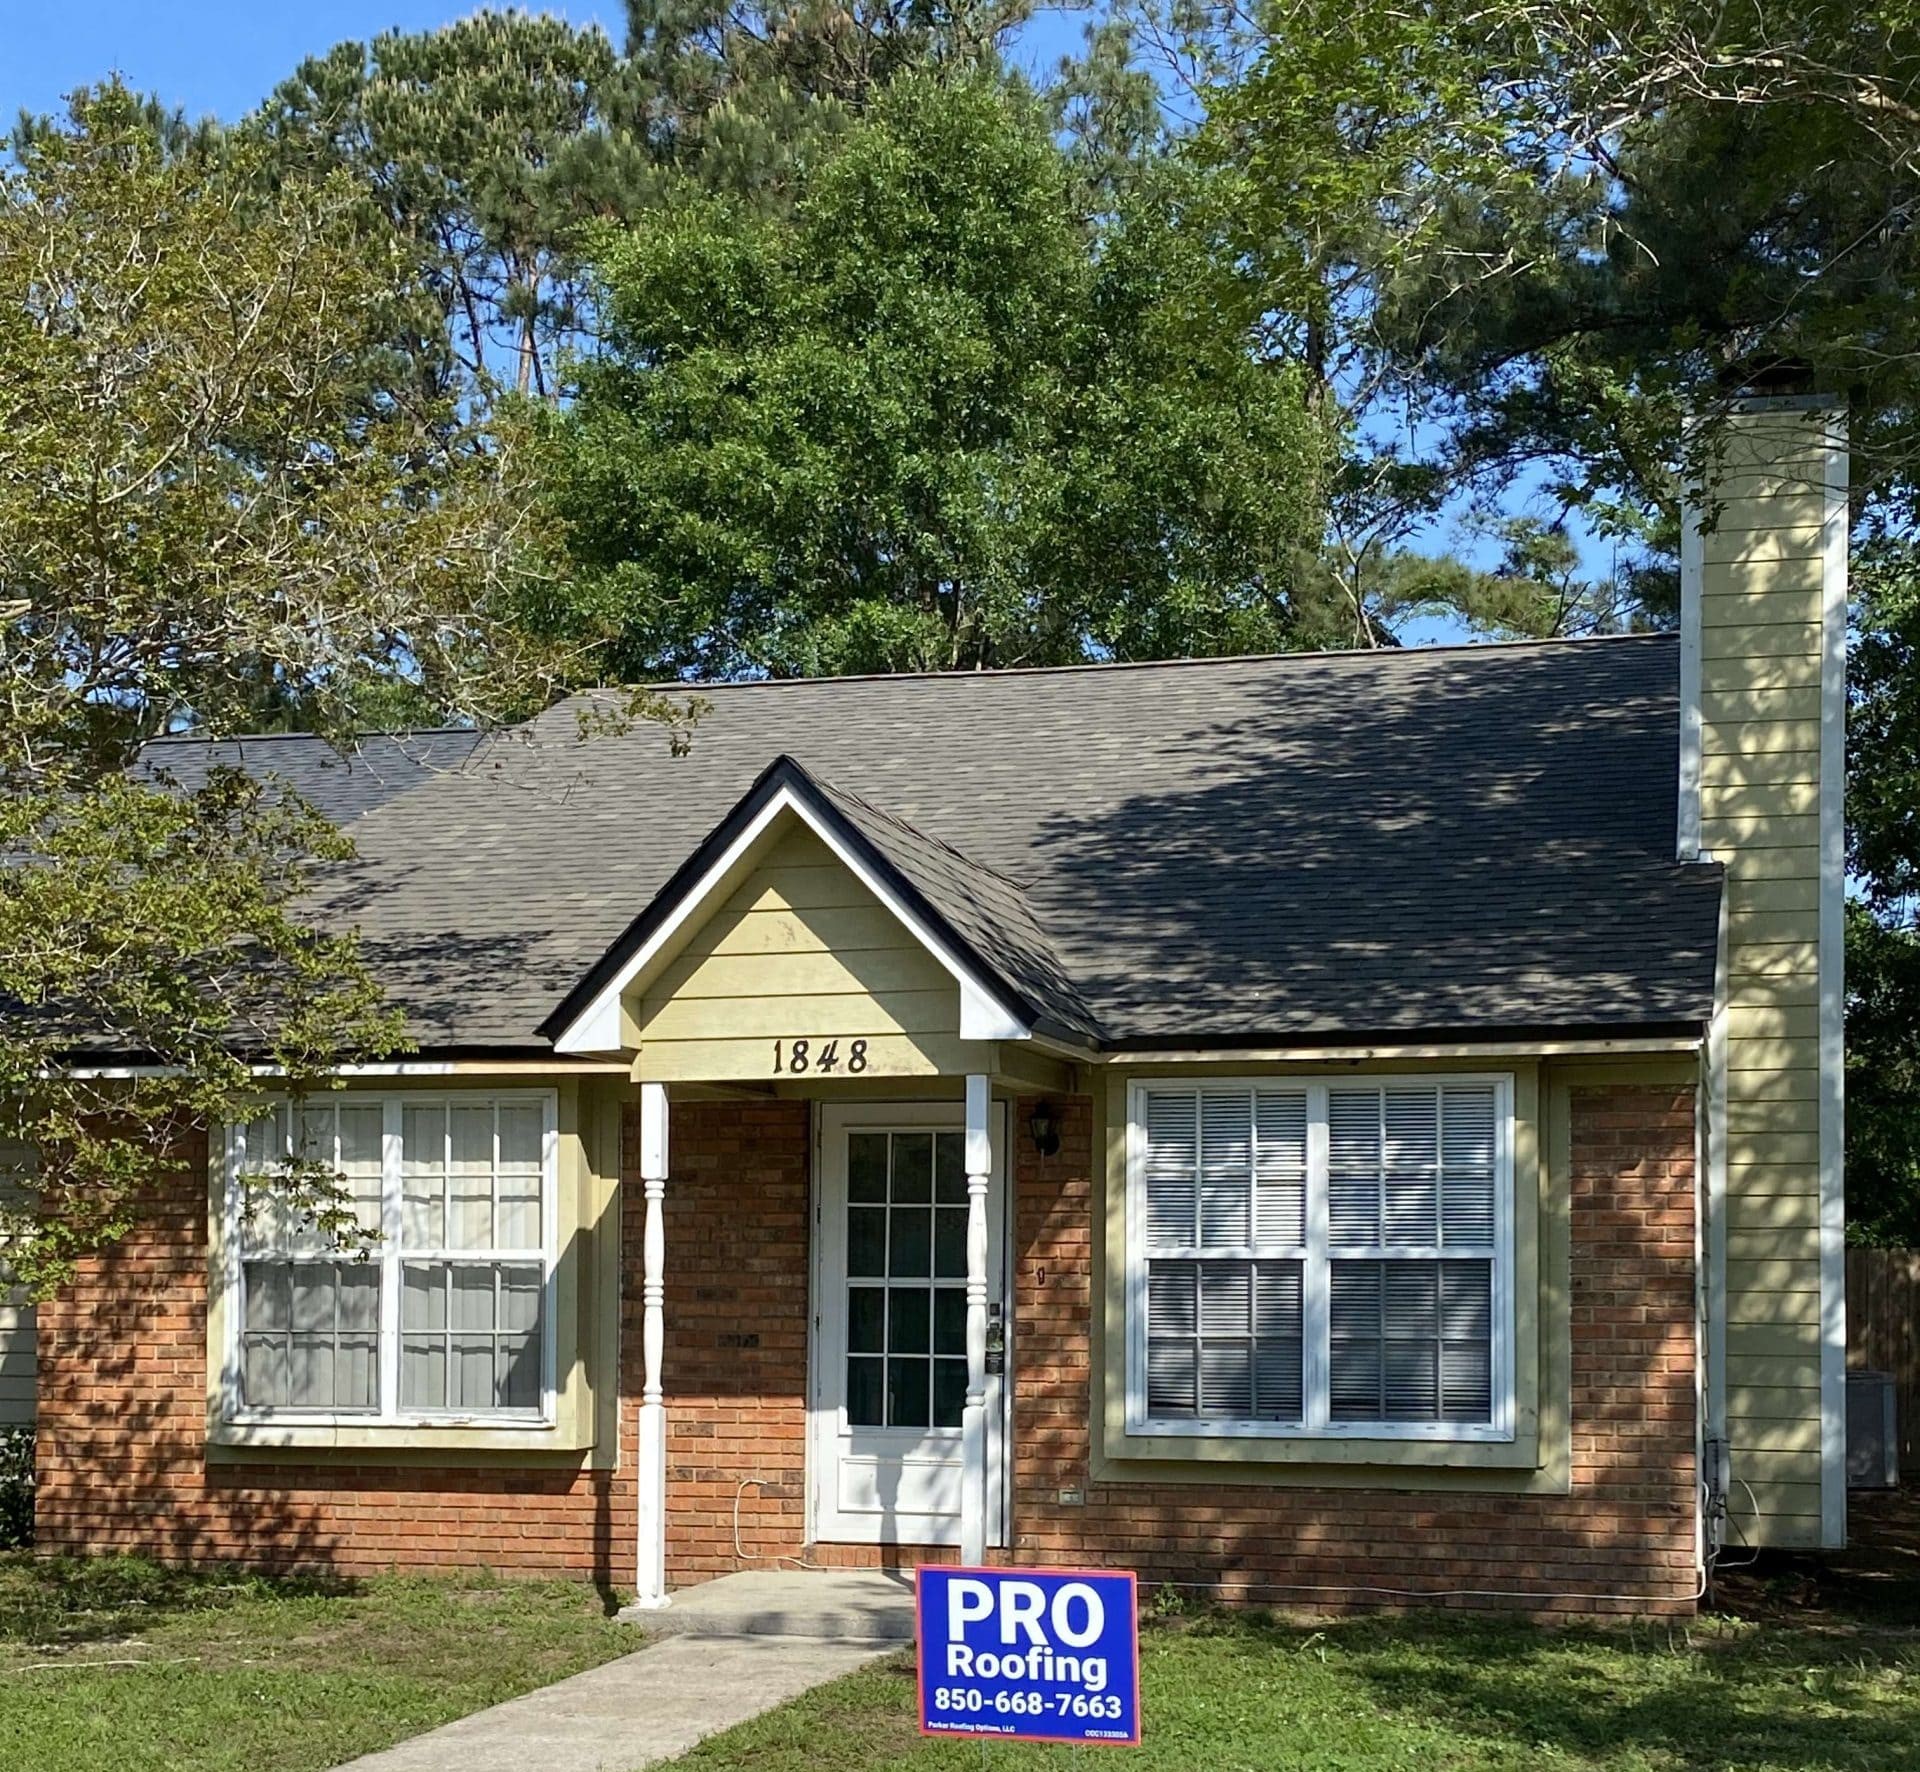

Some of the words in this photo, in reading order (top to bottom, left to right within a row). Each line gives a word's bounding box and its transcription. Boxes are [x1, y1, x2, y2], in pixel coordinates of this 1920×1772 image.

[773, 1039, 867, 1074] 1848
[947, 1578, 1105, 1648] PRO
[947, 1643, 1107, 1692] Roofing
[935, 1687, 1122, 1719] 850-668-7663
